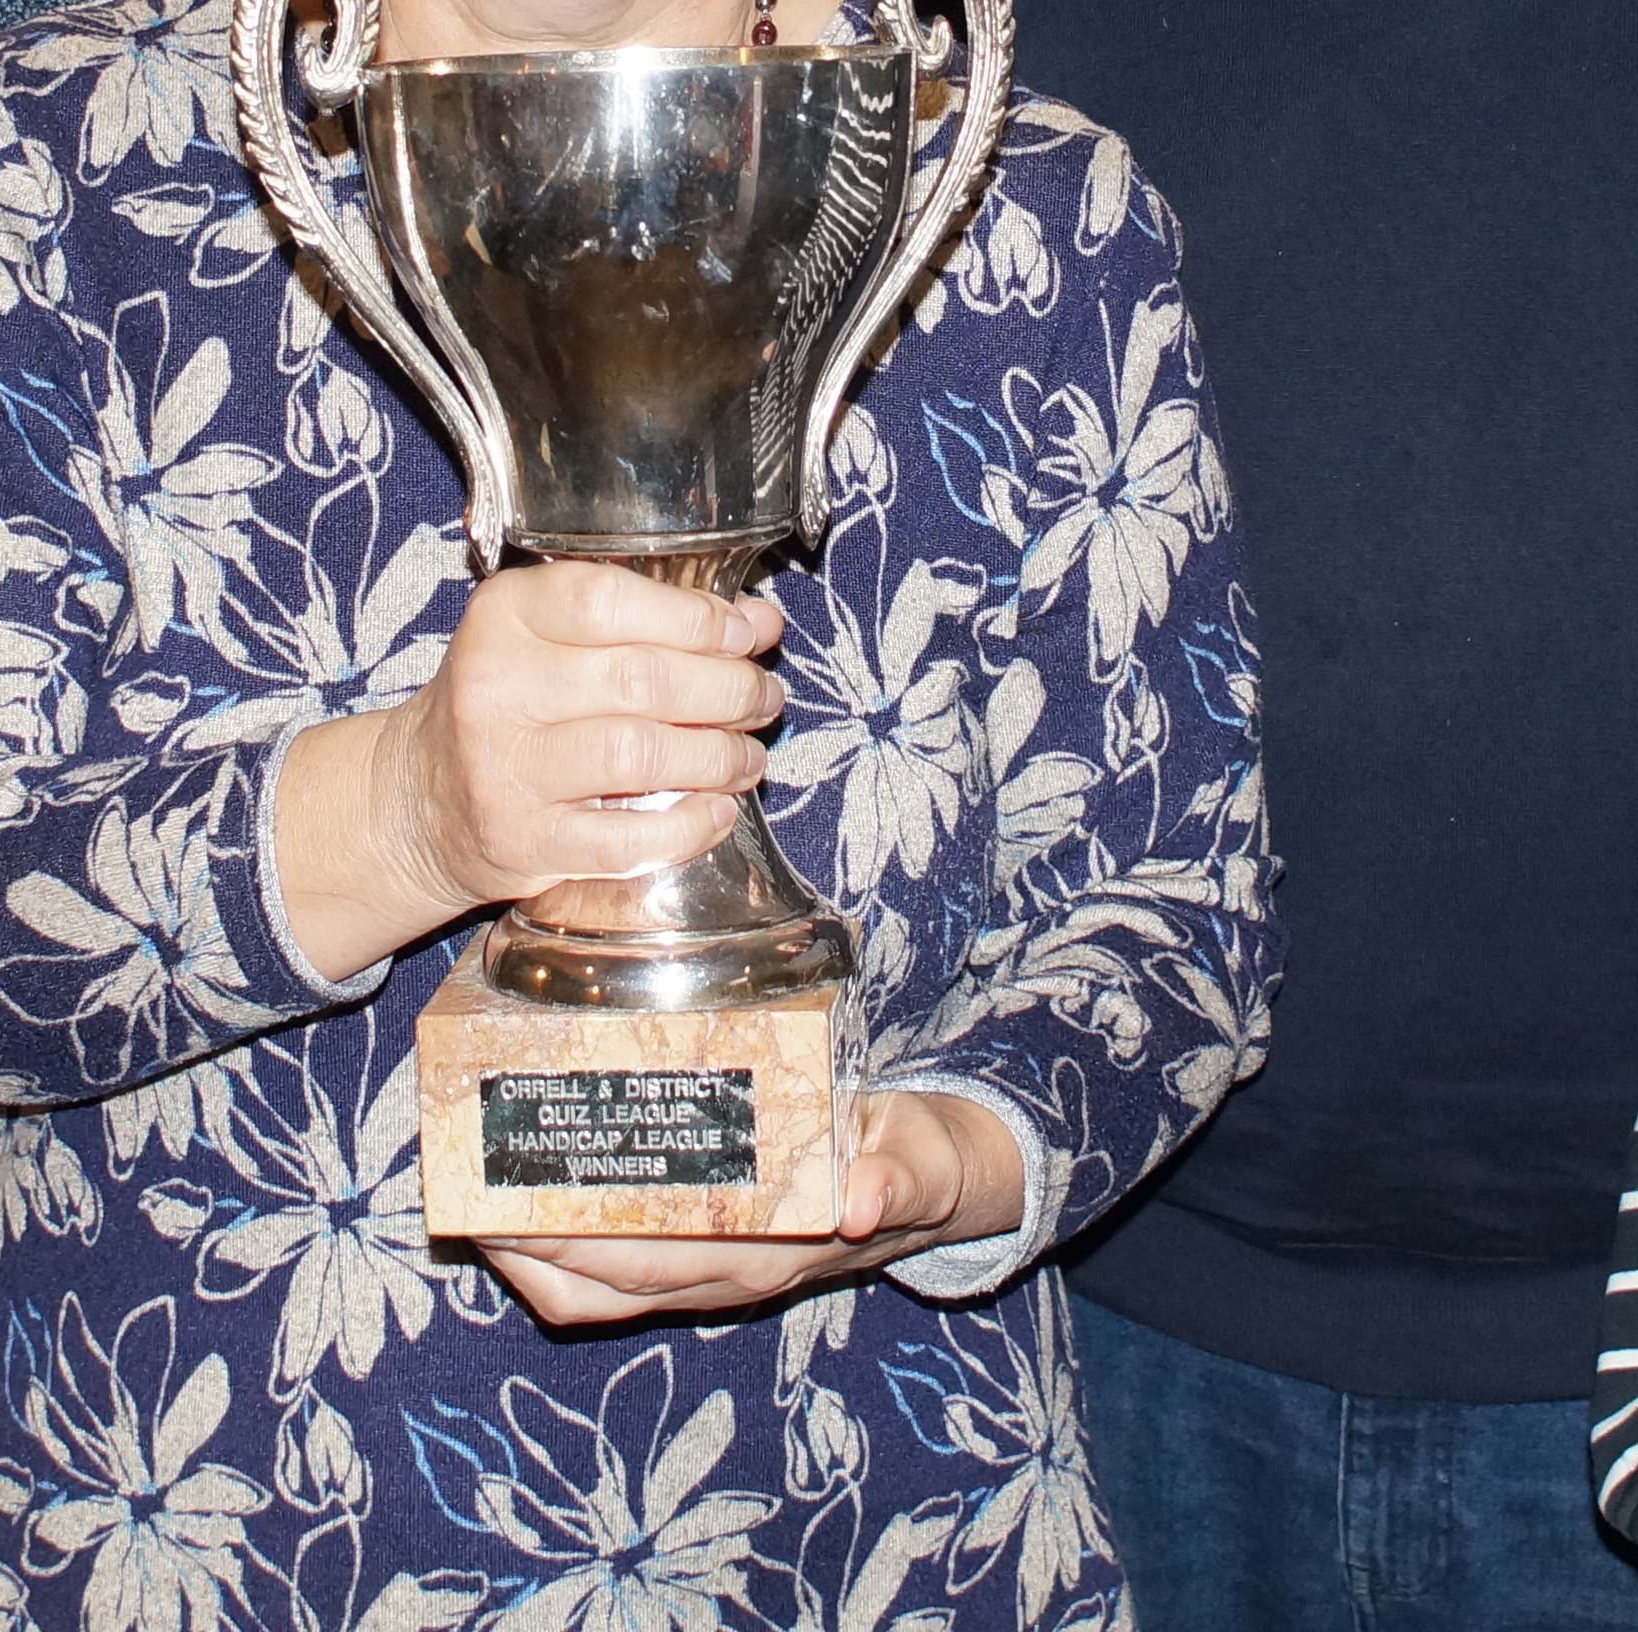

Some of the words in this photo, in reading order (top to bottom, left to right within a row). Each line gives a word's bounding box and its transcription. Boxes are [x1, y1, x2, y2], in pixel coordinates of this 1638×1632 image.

[499, 1078, 587, 1100] ORRELL
[598, 1079, 613, 1099] &
[624, 1077, 726, 1099] DISTRICT
[538, 1104, 591, 1126] QUIZ
[601, 1104, 691, 1125] LEAGUE
[508, 1130, 623, 1152] HANDICAP
[634, 1129, 723, 1151] LEAGUE
[565, 1156, 668, 1177] WINNERS
